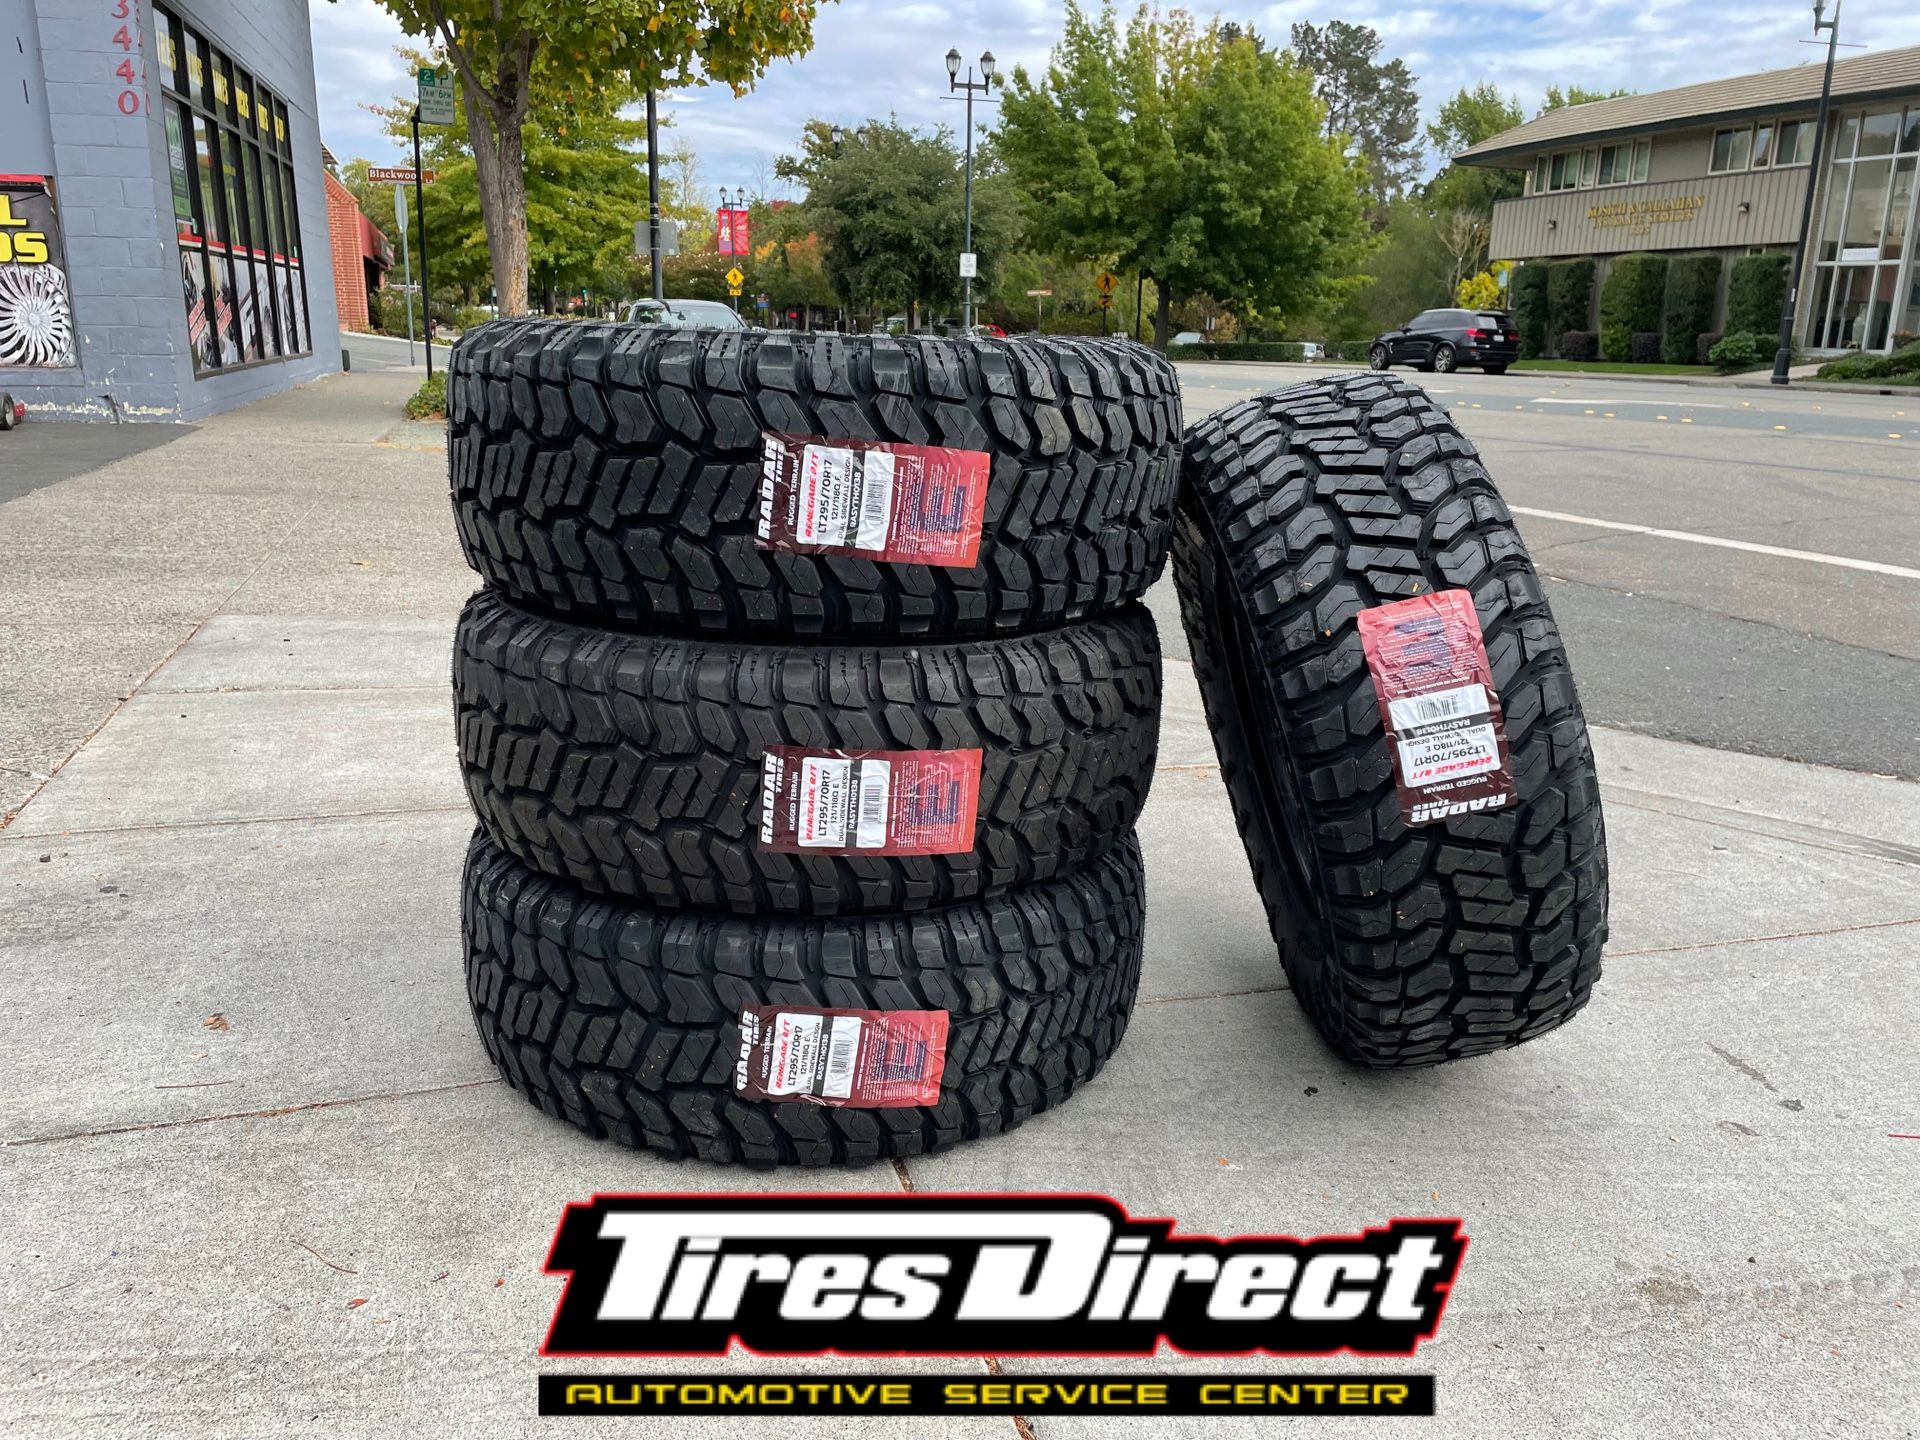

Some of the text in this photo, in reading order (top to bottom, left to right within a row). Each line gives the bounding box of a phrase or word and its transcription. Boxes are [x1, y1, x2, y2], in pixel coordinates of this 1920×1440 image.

[423, 70, 431, 80] 2
[422, 88, 434, 96] 7AM
[439, 90, 451, 98] 6PM
[370, 169, 422, 180] Blackwoo
[776, 444, 785, 482] TIRES
[758, 439, 777, 539] RADAR
[788, 459, 799, 525] RUGGED TERRAIN
[818, 459, 832, 533] LT295/70R17
[831, 484, 841, 520] 121/118Q
[841, 485, 849, 520] SIDEWALL
[805, 478, 816, 537] RENEGADE
[1433, 738, 1469, 750] 121/118Q
[1469, 726, 1486, 735] DUAL
[1411, 756, 1493, 780] RENEGADE R/T
[1414, 744, 1486, 767] LT295/70R17
[776, 758, 784, 792] TIRES
[790, 772, 799, 801] TERRAIN
[1424, 776, 1488, 794] RUGGED TERRAIN
[761, 753, 778, 844] RADAR
[806, 788, 815, 840] RENEGADE
[818, 770, 830, 836] LT295/70R17
[831, 791, 839, 824] 121/118Q
[1411, 793, 1507, 822] RADAR
[1413, 799, 1450, 811] TIRES
[736, 1010, 753, 1090] RADAR
[775, 1041, 788, 1089] RENEGADE
[787, 1026, 803, 1086] LT295/70R17
[801, 1045, 810, 1074] 121/118Q
